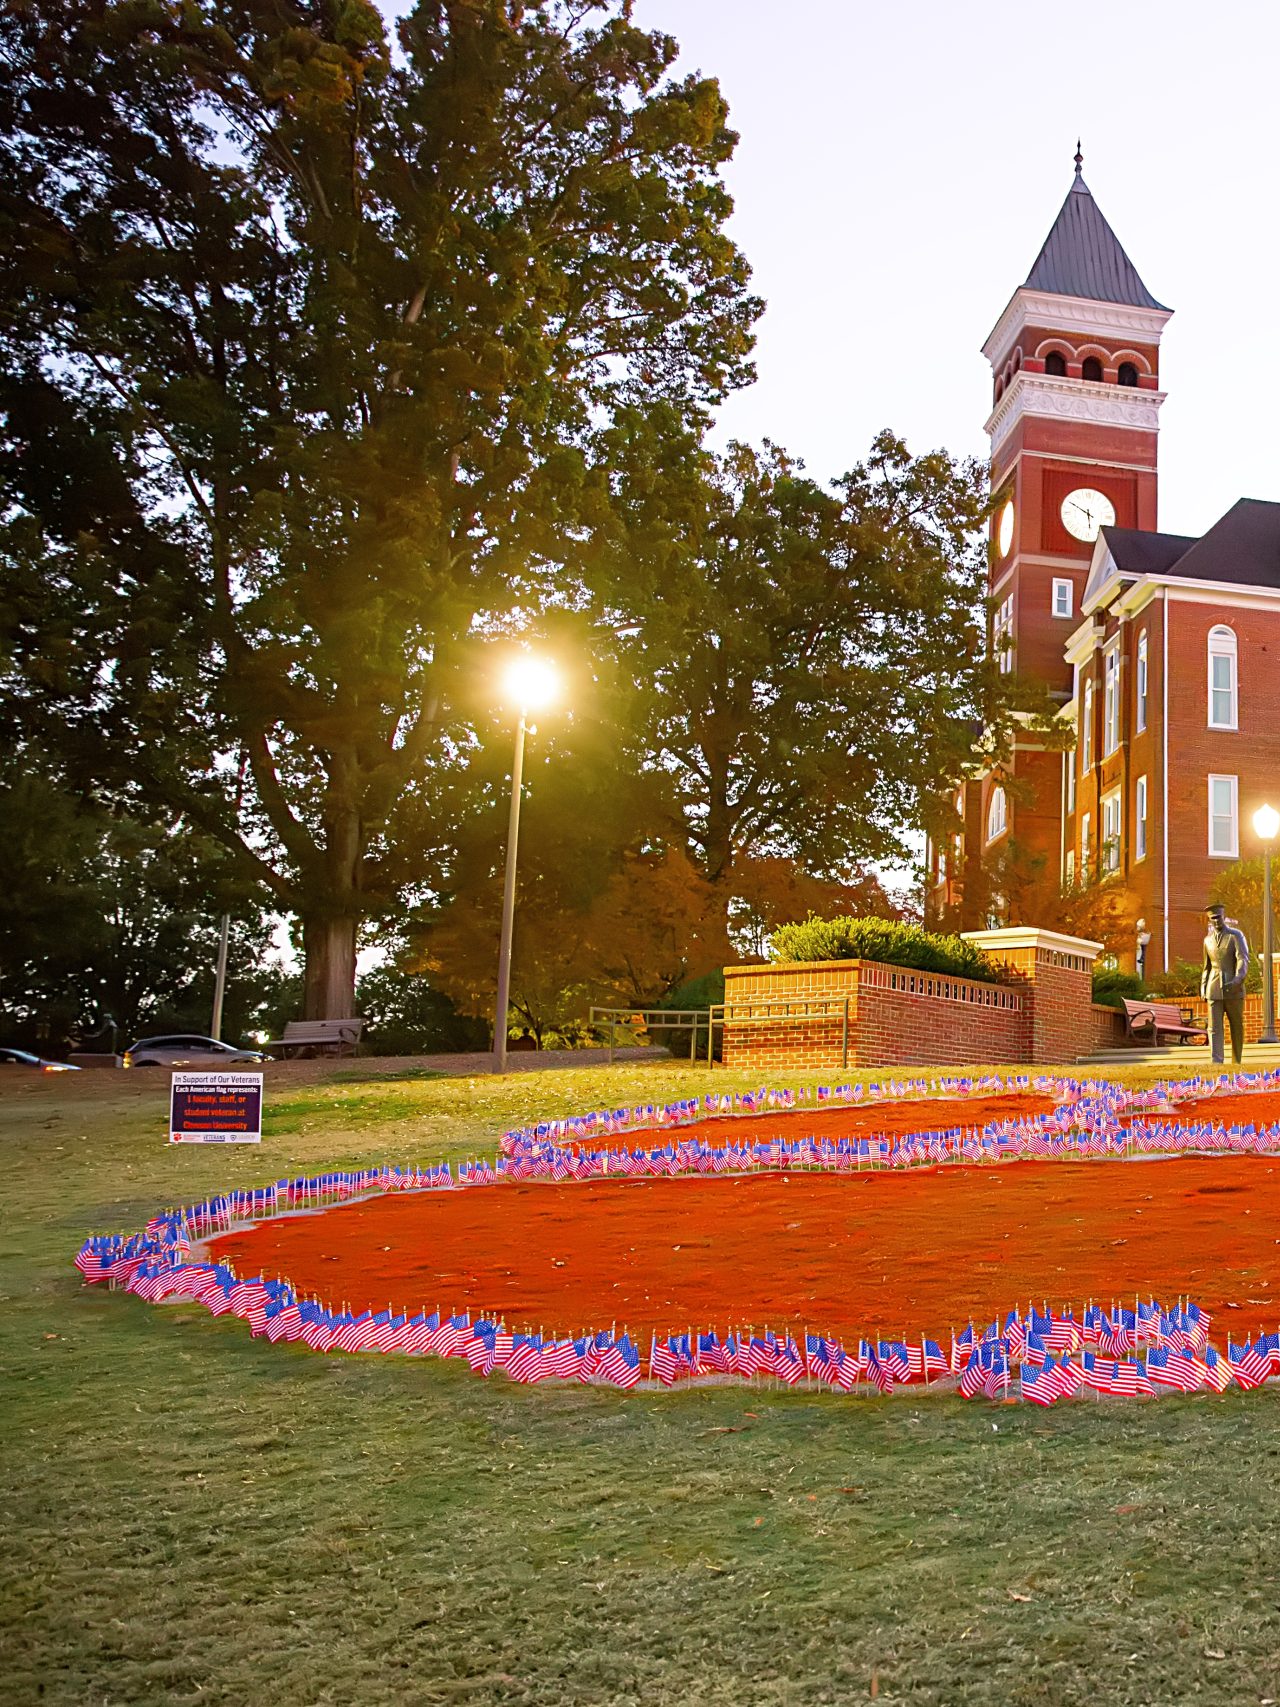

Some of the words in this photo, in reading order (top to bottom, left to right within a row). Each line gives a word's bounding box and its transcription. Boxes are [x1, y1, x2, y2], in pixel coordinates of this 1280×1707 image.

[183, 1076, 208, 1084] Support
[231, 1076, 260, 1084] Veterans
[216, 1086, 227, 1094] flag
